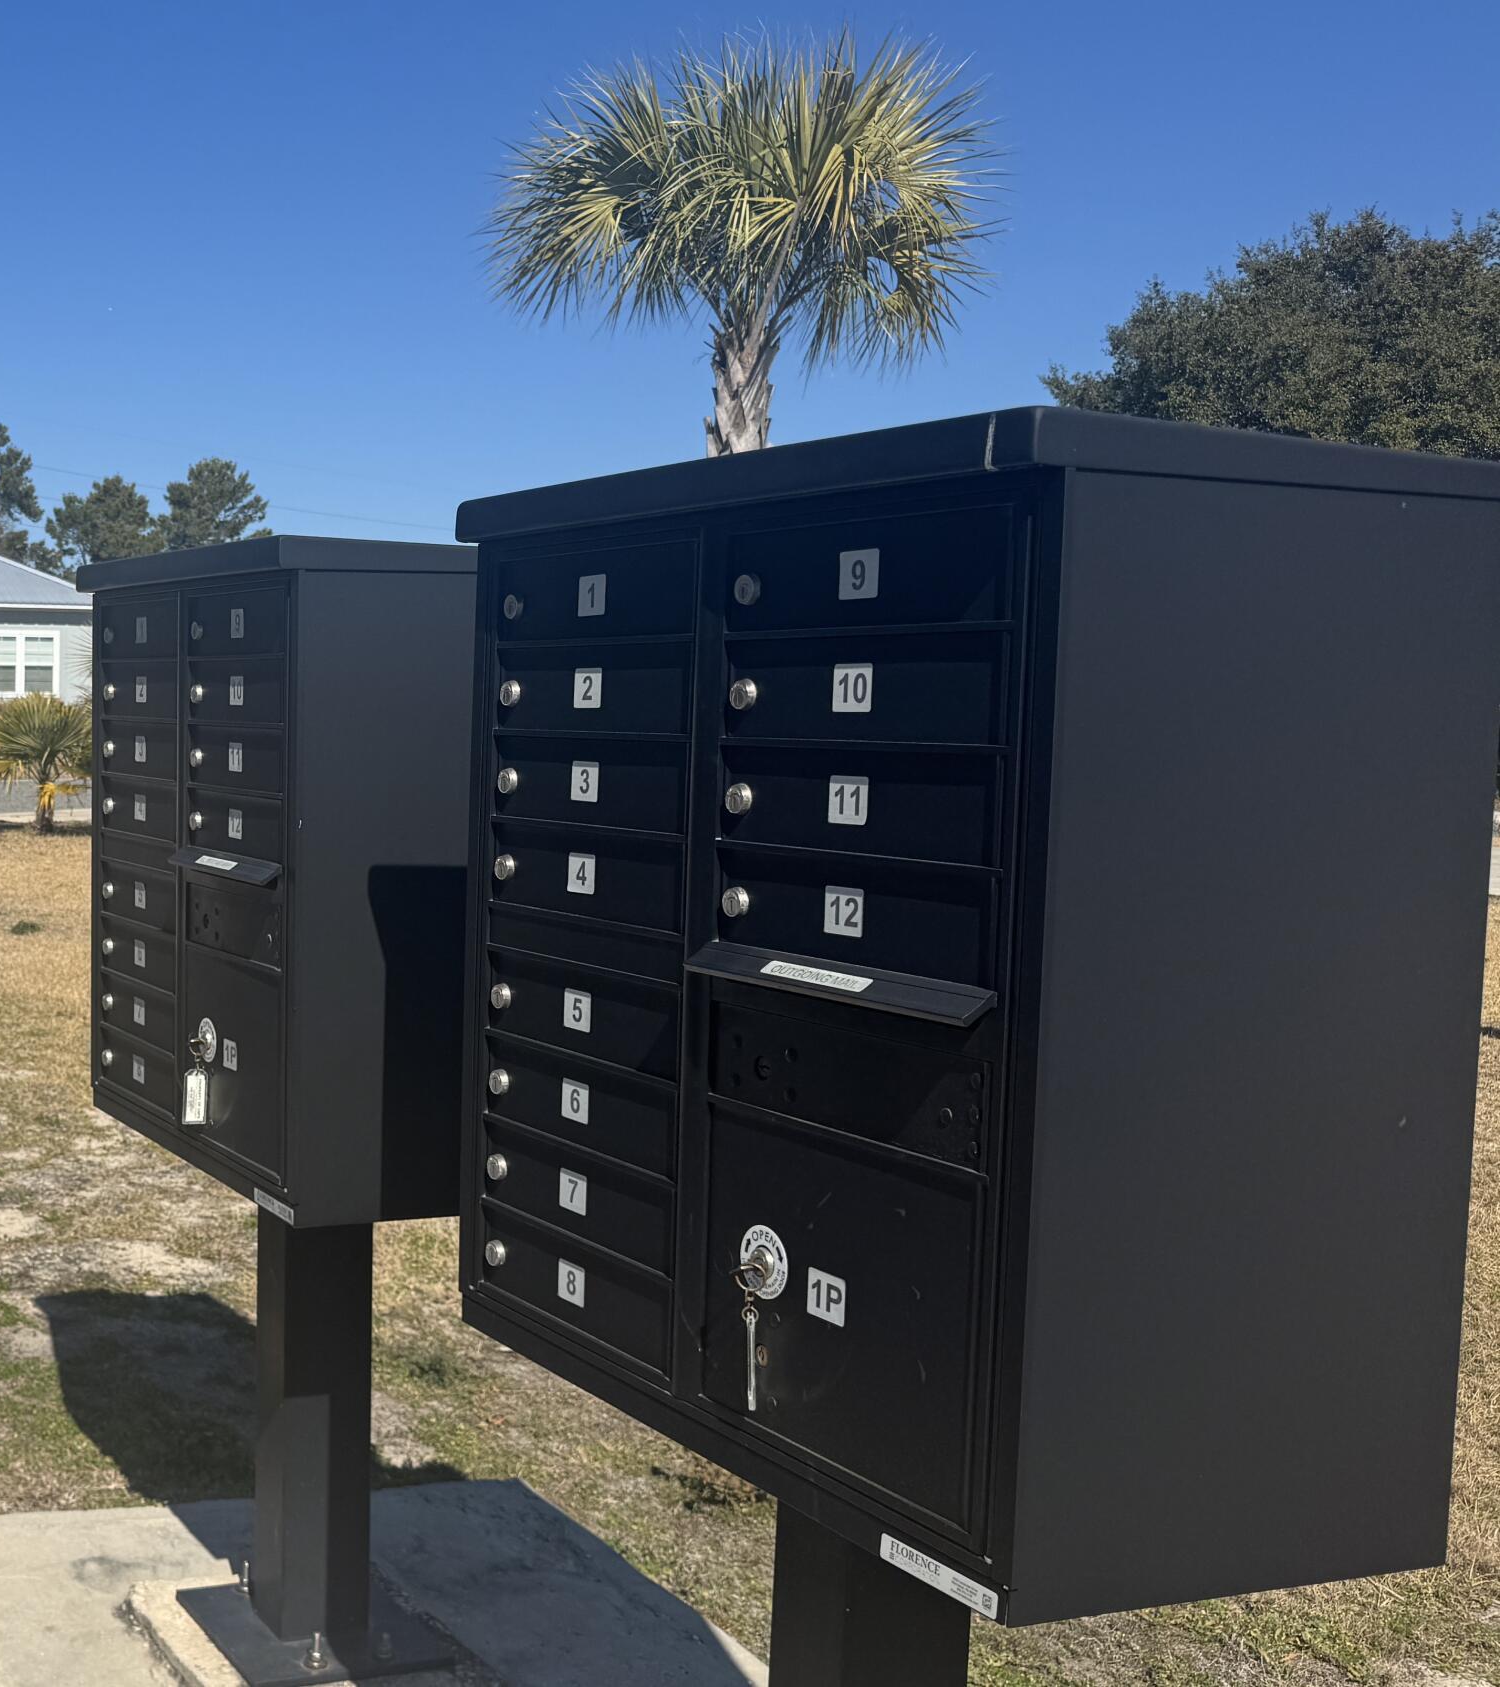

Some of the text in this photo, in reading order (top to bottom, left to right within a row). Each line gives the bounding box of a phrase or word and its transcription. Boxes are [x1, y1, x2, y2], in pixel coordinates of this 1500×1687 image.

[851, 559, 866, 591] 9
[587, 582, 596, 608] 1
[232, 682, 242, 700] 10
[581, 675, 593, 701] 2
[838, 672, 867, 703] 10
[231, 748, 240, 766] 11
[580, 768, 590, 794] 3
[834, 784, 861, 816] 11
[231, 815, 241, 833] 12
[576, 860, 587, 886] 4
[830, 895, 859, 928] 12
[771, 965, 860, 990] OUTGOING MAIL
[572, 997, 583, 1023] 5
[225, 1044, 237, 1065] 1P
[570, 1088, 581, 1114] 6
[568, 1178, 579, 1203] 7
[751, 1230, 777, 1248] OPEN
[566, 1269, 576, 1296] 8
[812, 1278, 843, 1313] 1P
[890, 1540, 941, 1577] FLORENCE
